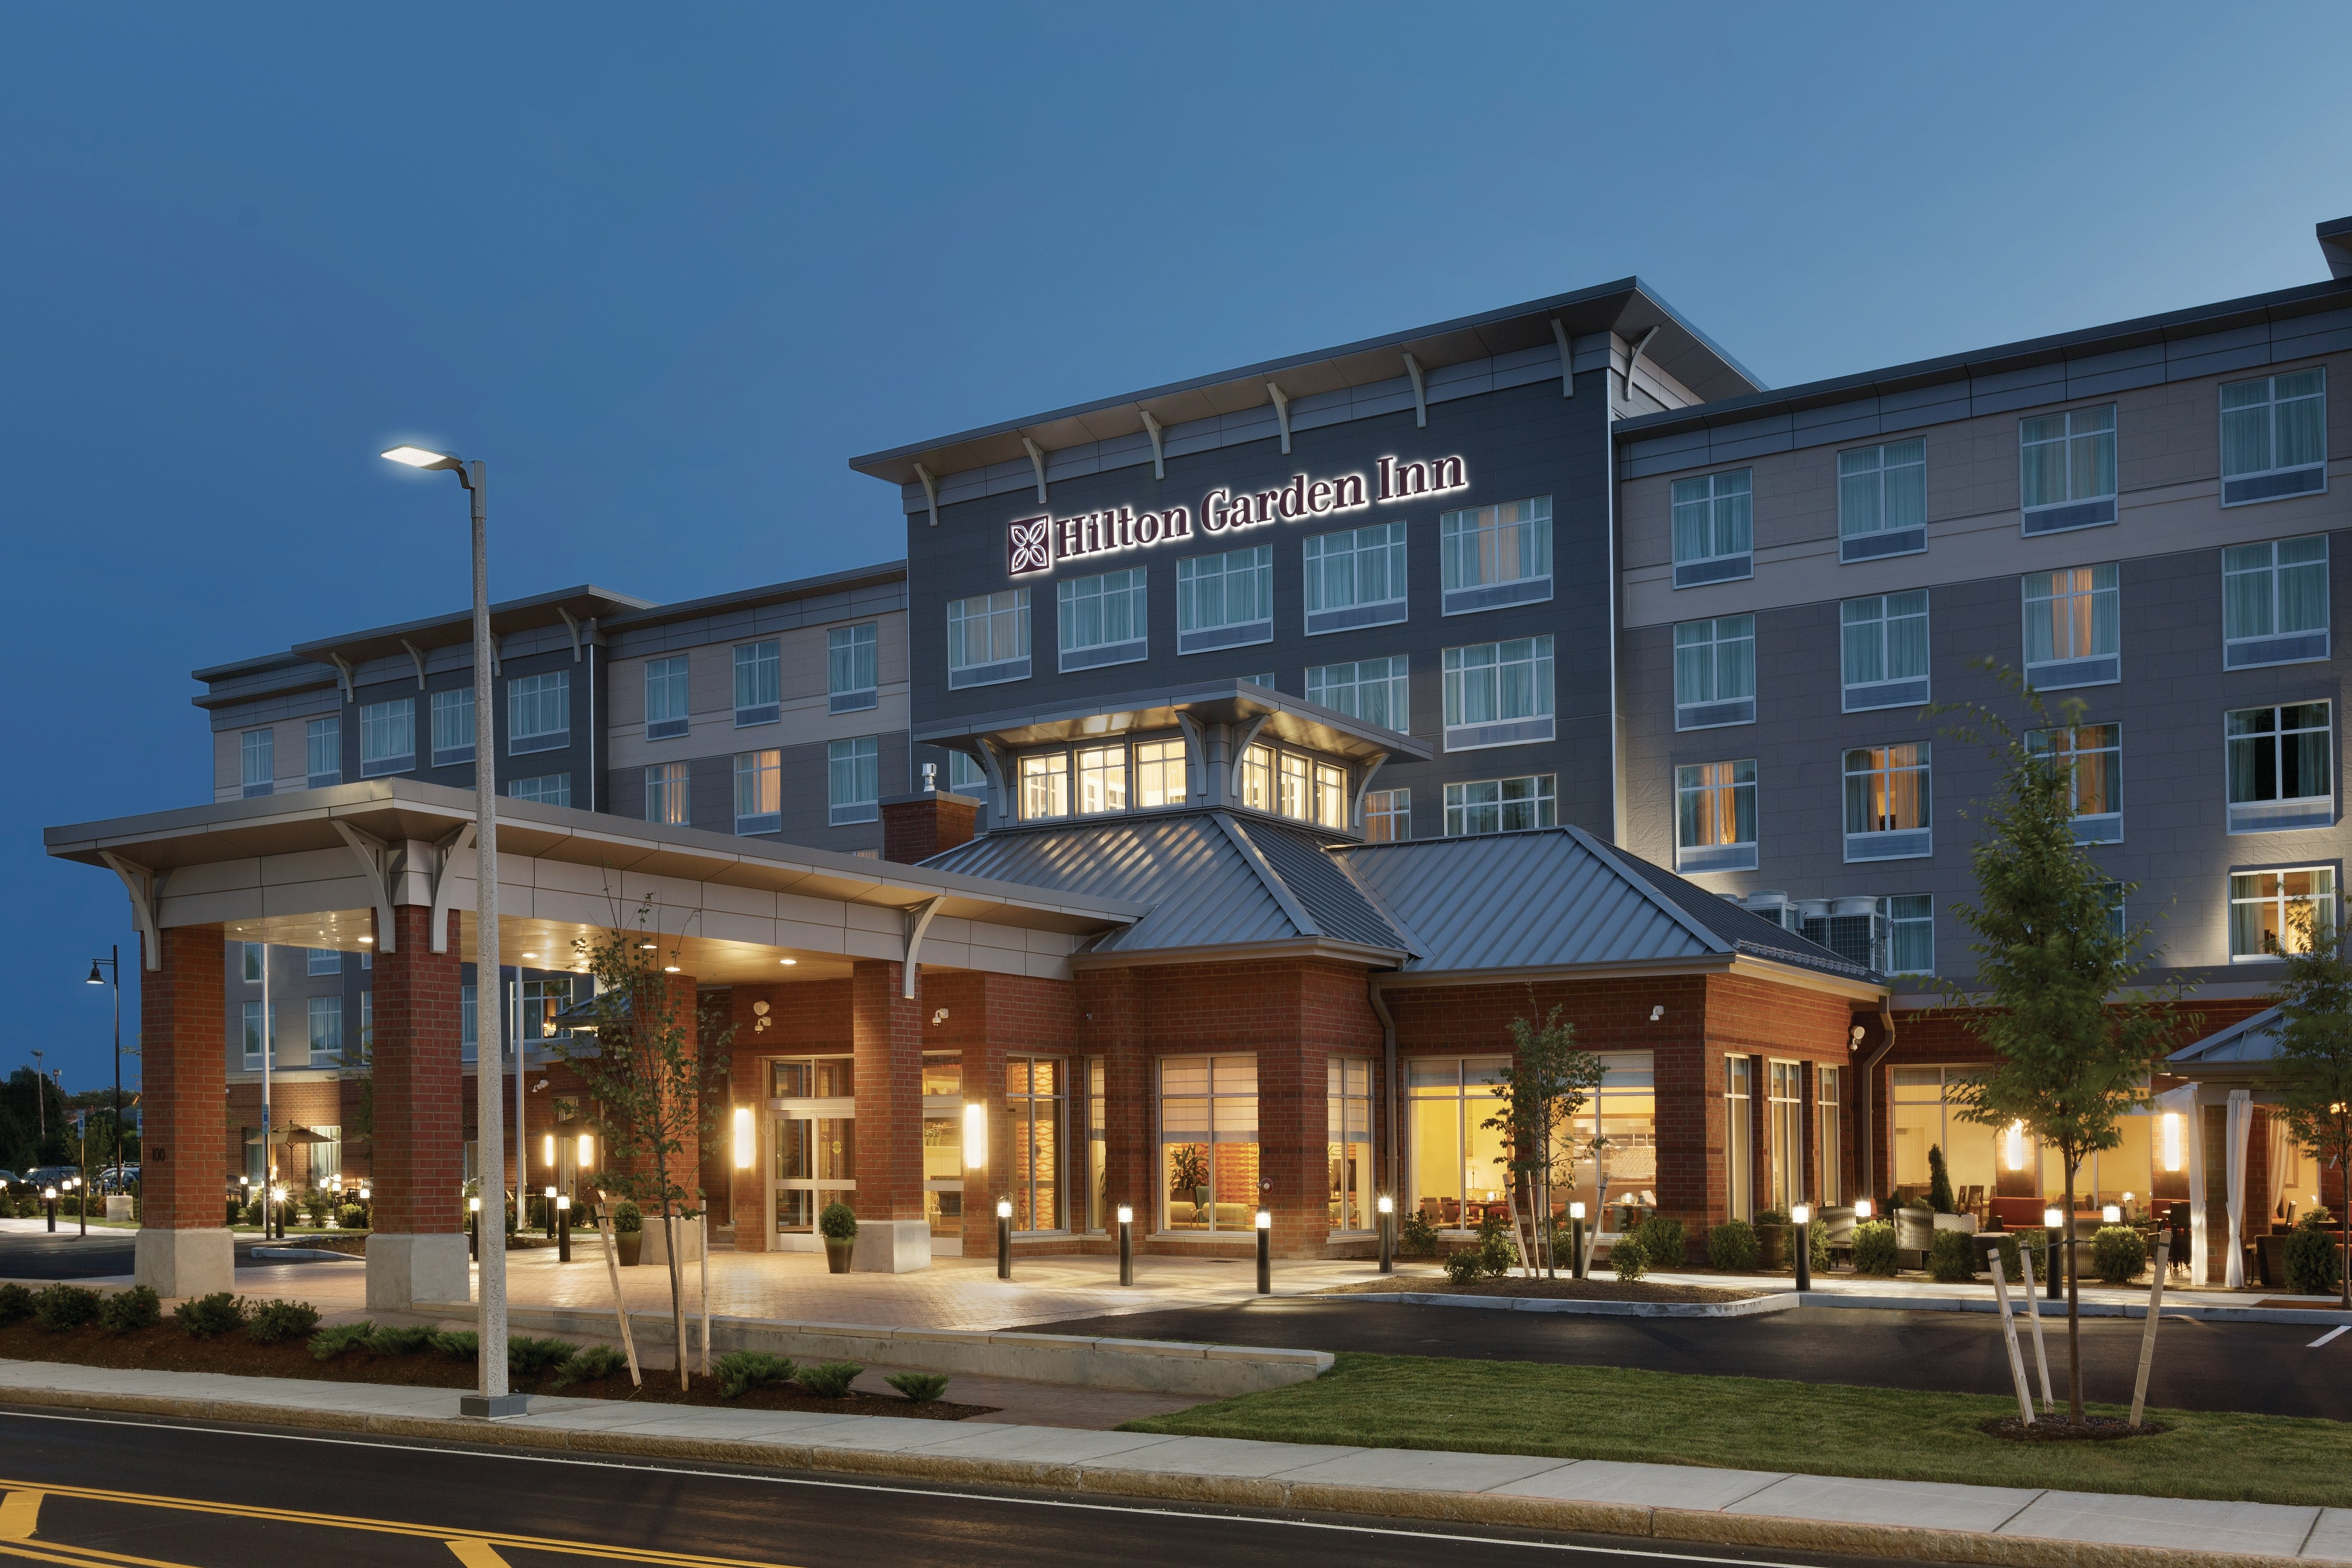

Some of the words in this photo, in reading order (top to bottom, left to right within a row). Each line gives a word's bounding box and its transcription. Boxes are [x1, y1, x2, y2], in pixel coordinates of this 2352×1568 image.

[1056, 508, 1190, 559] Hilton
[1201, 475, 1365, 531] Garden
[1377, 456, 1466, 501] Inn
[152, 1147, 165, 1162] 100
